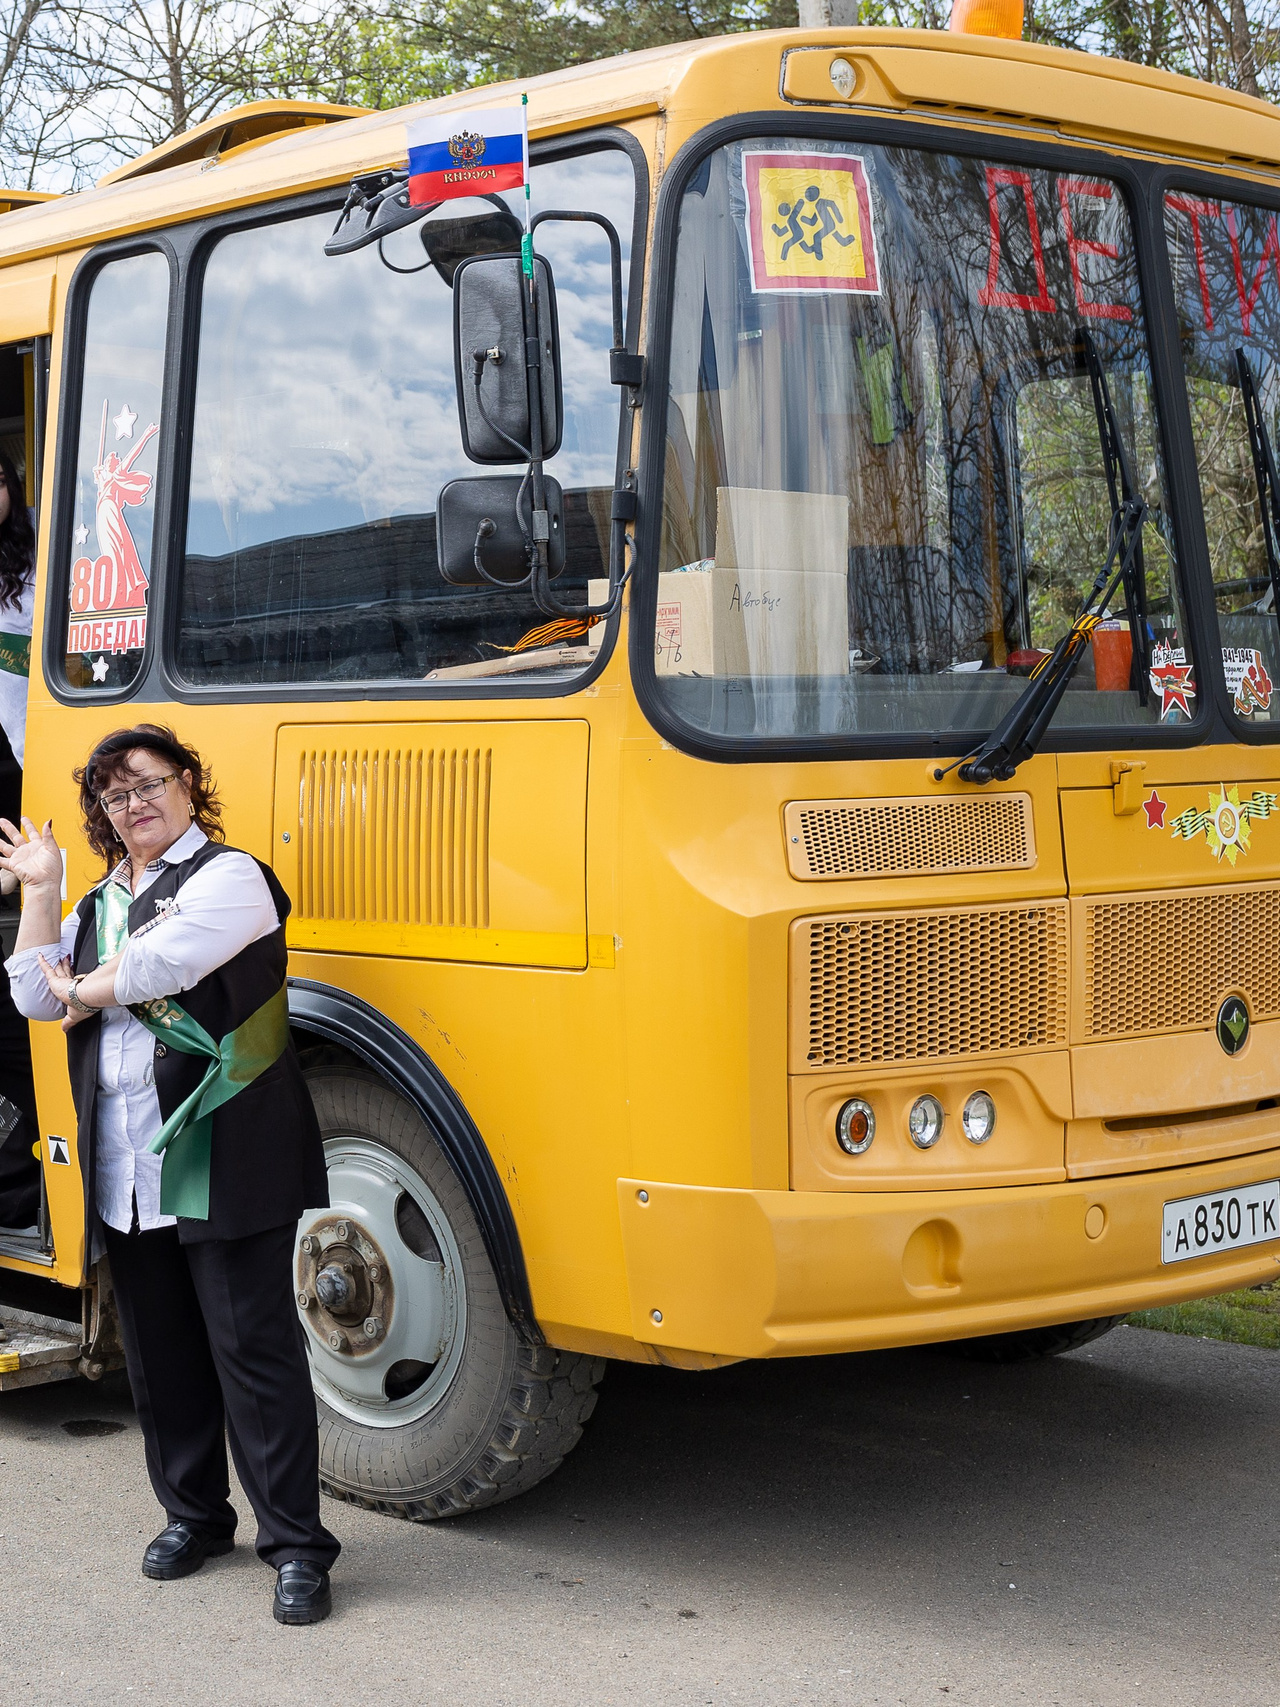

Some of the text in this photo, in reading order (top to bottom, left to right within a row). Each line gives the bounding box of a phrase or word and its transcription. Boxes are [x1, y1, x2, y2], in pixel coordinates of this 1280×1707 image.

[72, 555, 114, 613] 80
[729, 583, 781, 612] Автобус
[68, 618, 146, 654] ПОБЕДА!
[1221, 649, 1253, 663] 941-1945
